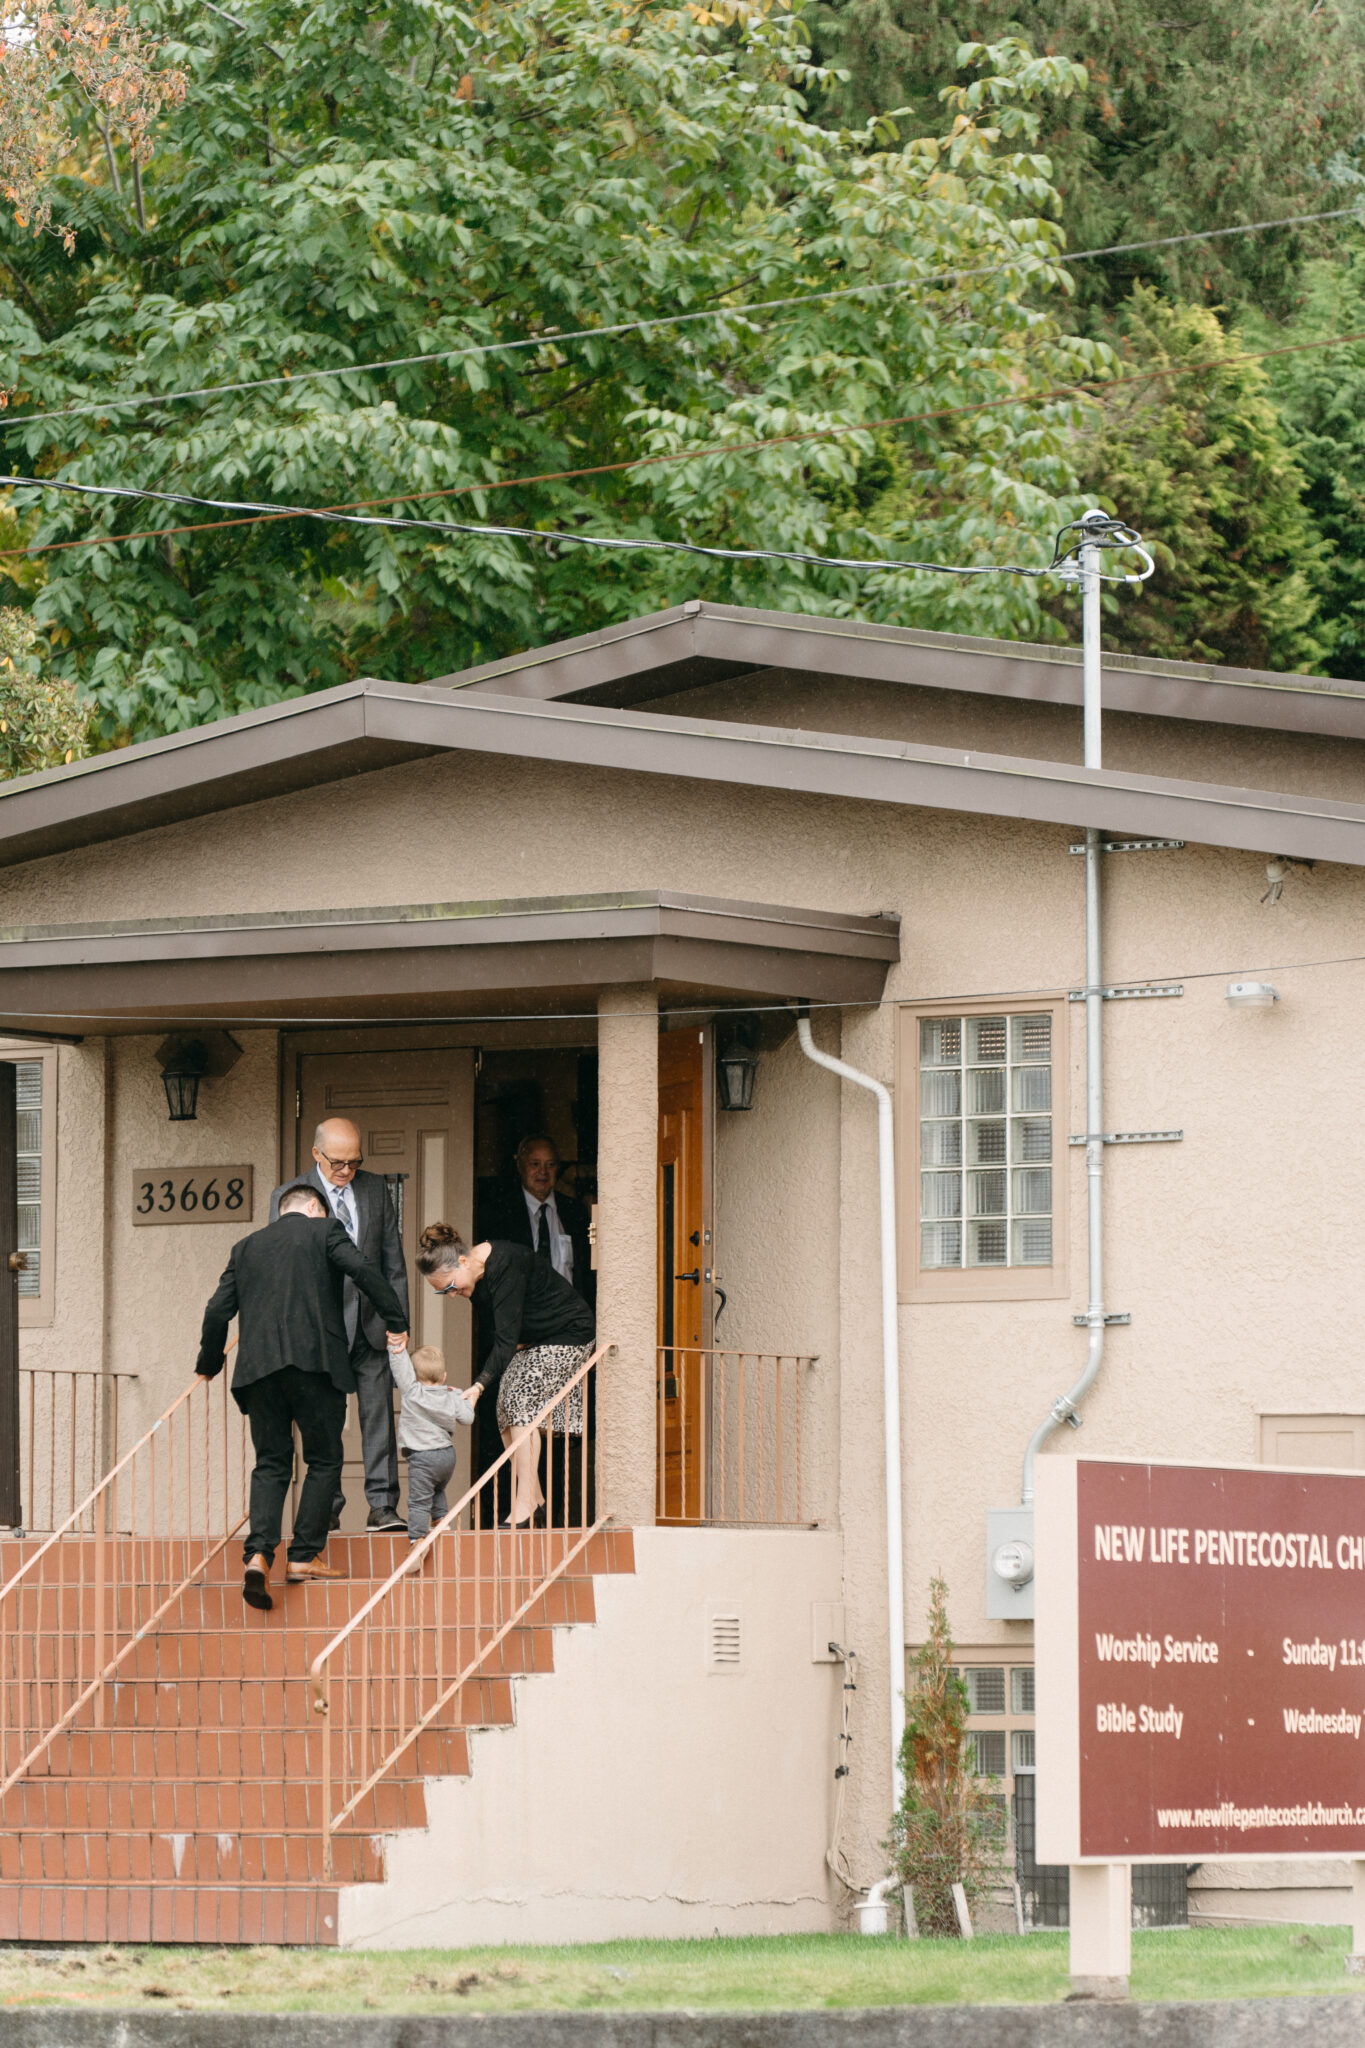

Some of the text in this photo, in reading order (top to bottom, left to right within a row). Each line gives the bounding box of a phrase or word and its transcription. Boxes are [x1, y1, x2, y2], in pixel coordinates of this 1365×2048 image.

[137, 1178, 244, 1214] 33668
[1094, 1524, 1365, 1570] NEW LIFE PENTECOSTAL CH
[1095, 1632, 1162, 1669] Worship
[1164, 1634, 1219, 1663] Service
[1282, 1636, 1337, 1672] Sunday
[1096, 1702, 1136, 1733] Bible
[1138, 1703, 1184, 1740] Study
[1282, 1707, 1362, 1740] Wednesday
